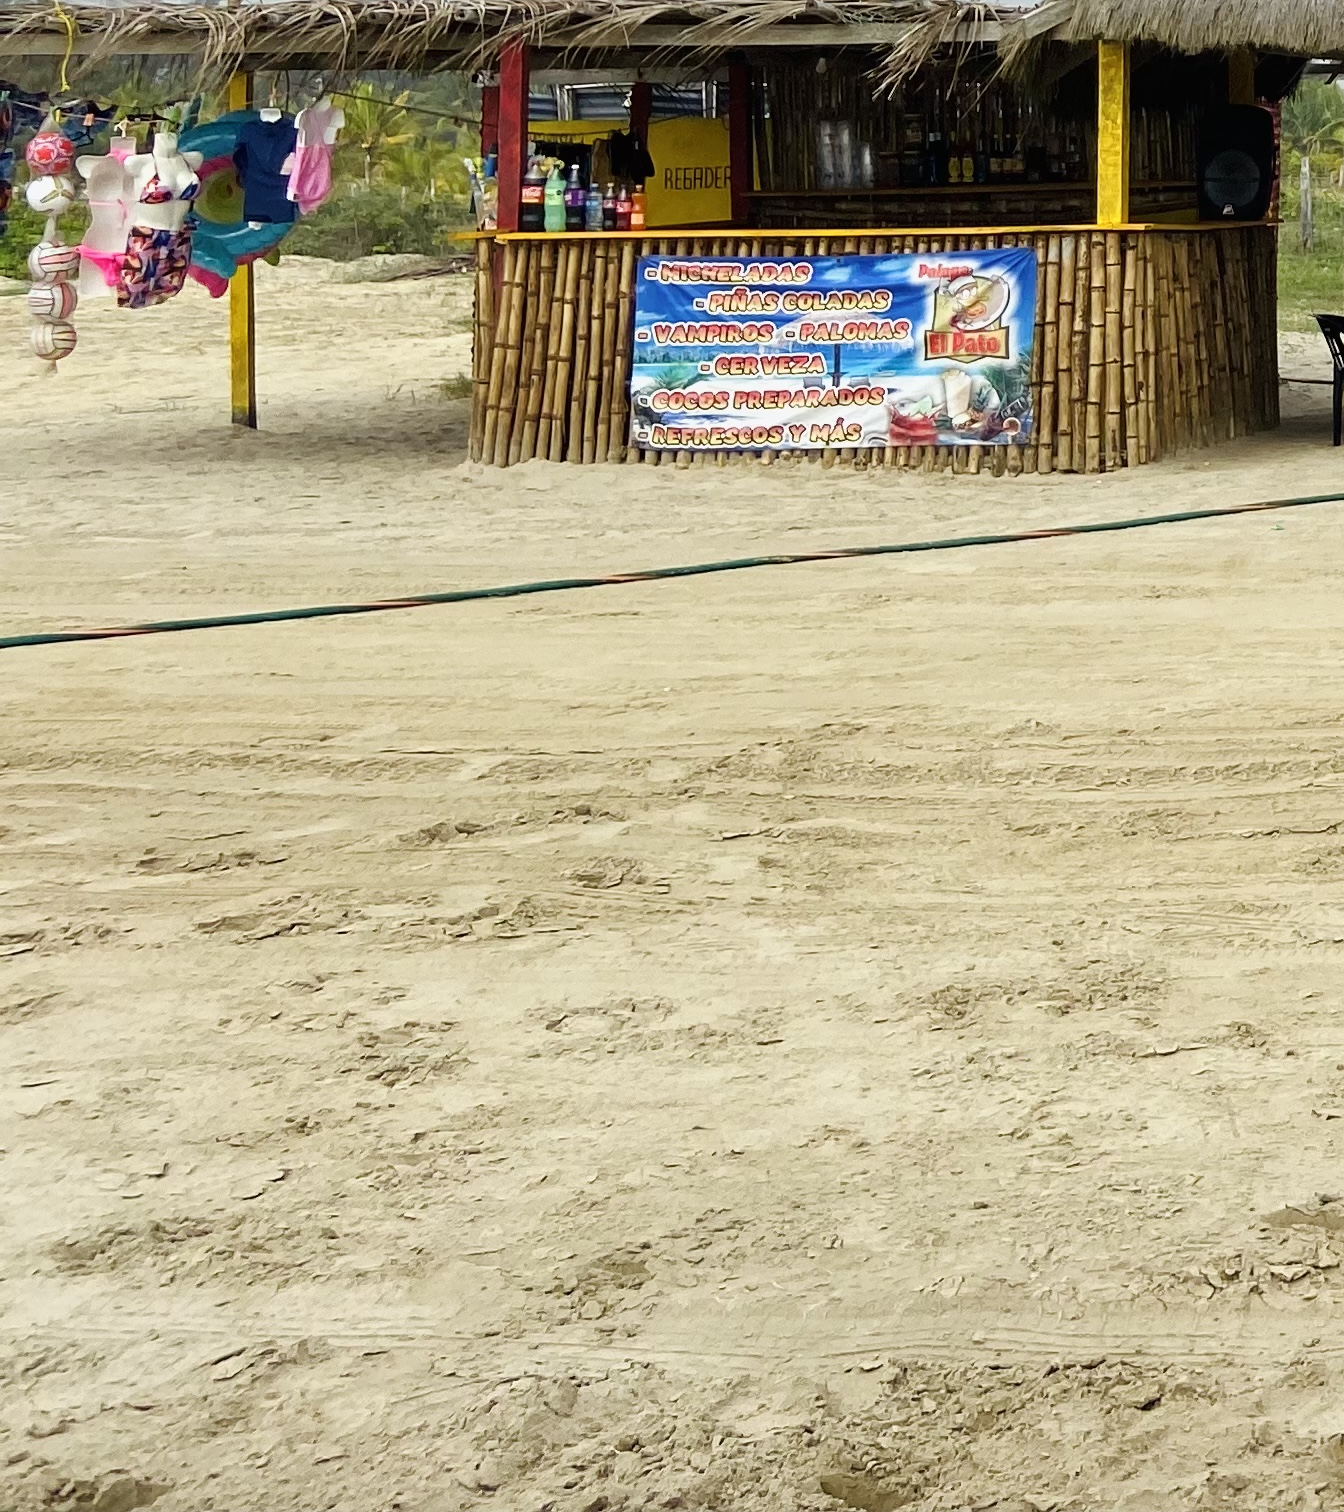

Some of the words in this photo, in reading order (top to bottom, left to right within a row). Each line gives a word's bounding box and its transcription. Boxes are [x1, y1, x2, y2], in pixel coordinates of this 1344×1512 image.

[664, 165, 731, 190] REGADER
[660, 263, 810, 283] MICHELADAS
[708, 288, 779, 312] PIÑAS
[782, 291, 890, 312] COLADAS
[654, 323, 775, 343] VAMPIROS
[800, 321, 910, 342] PALOMAS
[952, 332, 1000, 354] Pato
[714, 355, 825, 375] CERVEZA
[652, 391, 730, 411] COCOS
[733, 386, 886, 410] PREPARADOS
[652, 424, 784, 446] REFRESCOS
[789, 424, 806, 443] Y
[809, 416, 862, 445] MÁS
